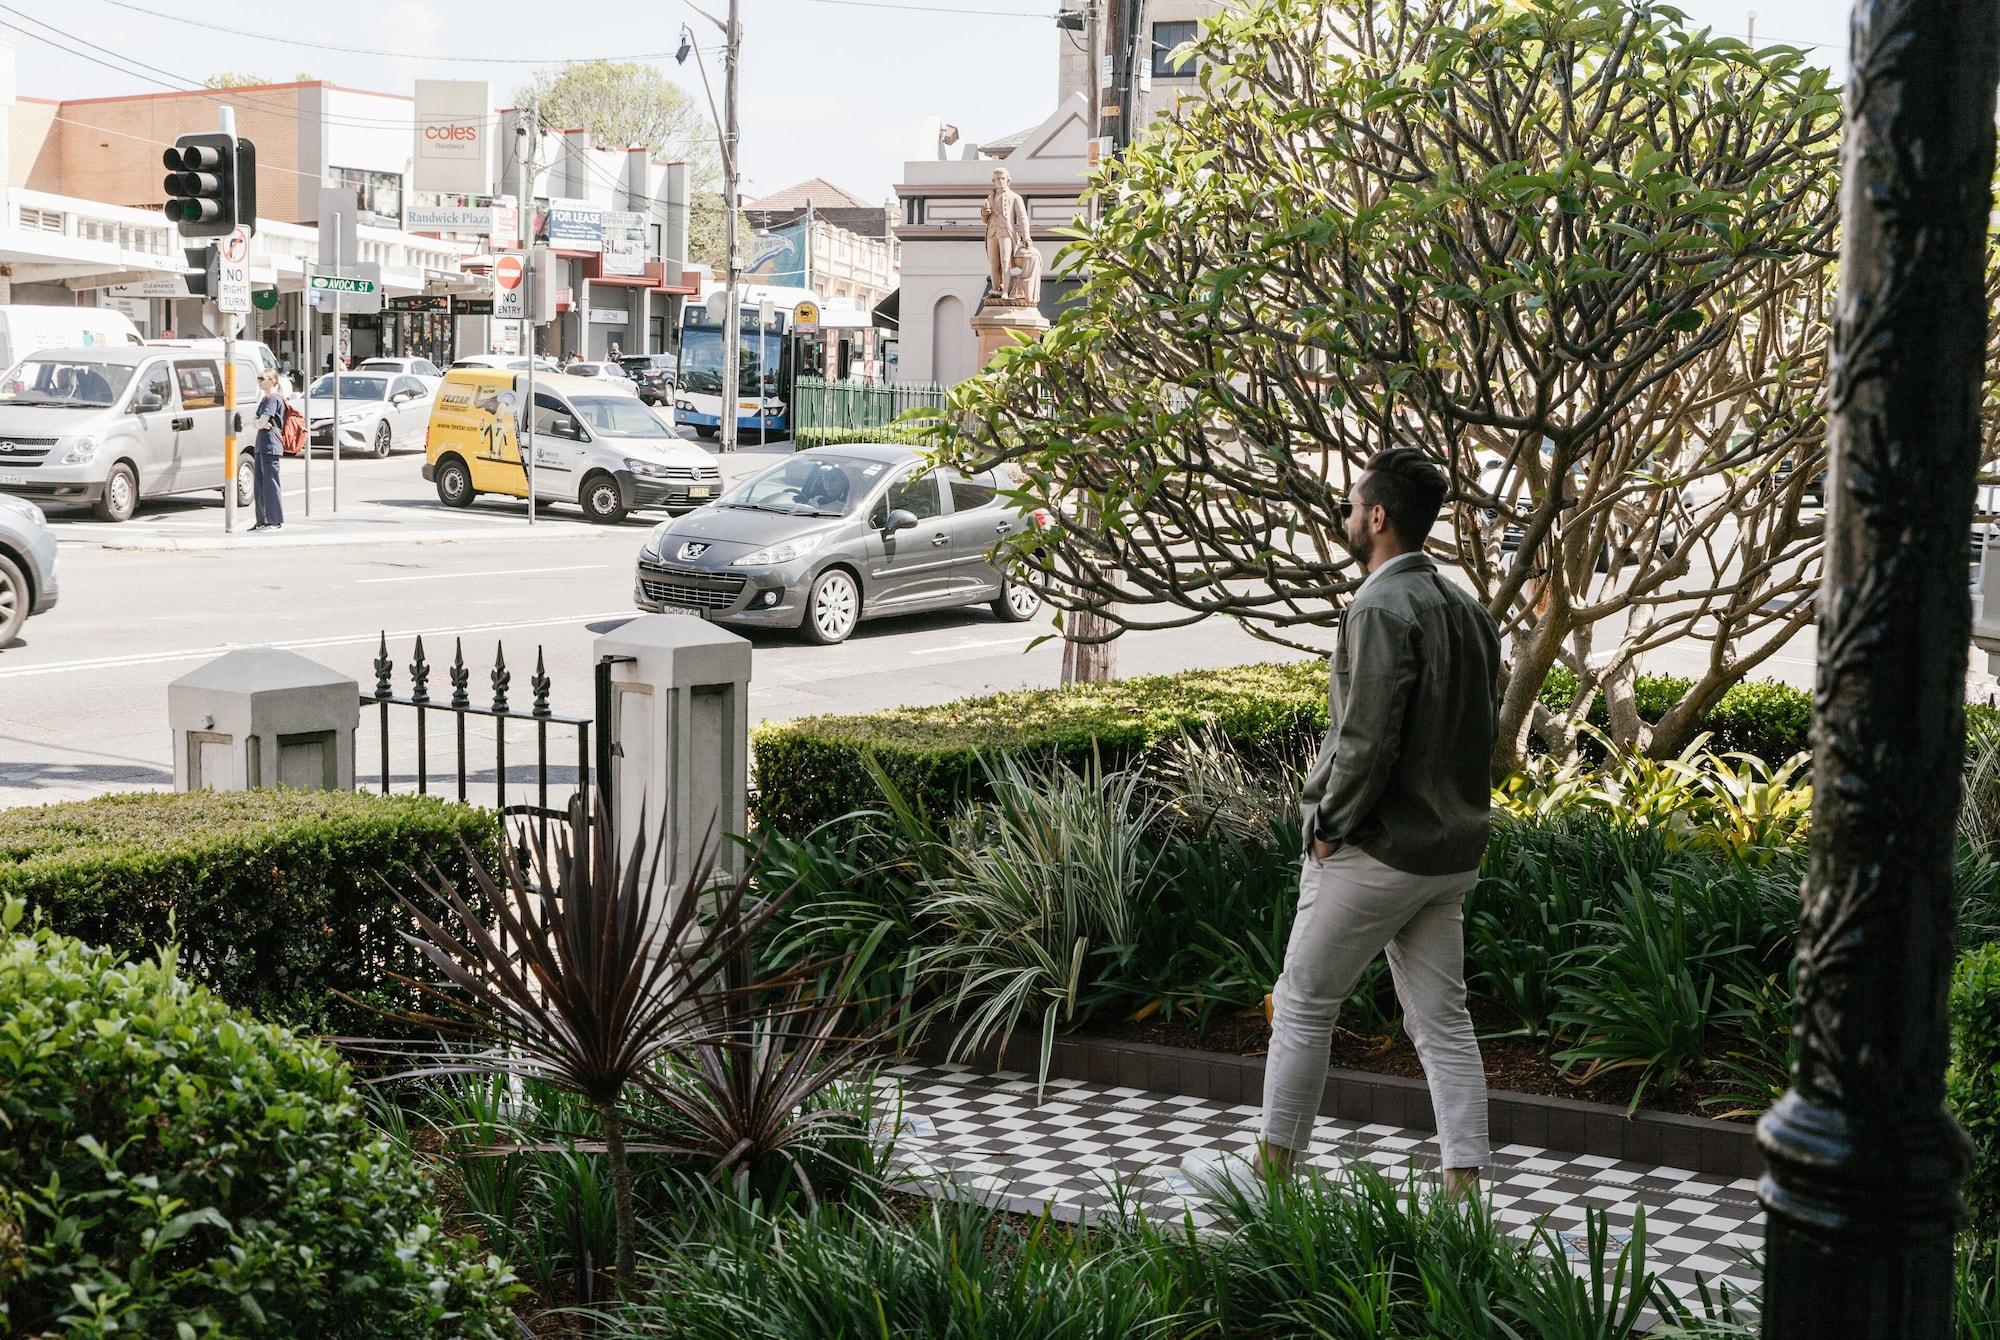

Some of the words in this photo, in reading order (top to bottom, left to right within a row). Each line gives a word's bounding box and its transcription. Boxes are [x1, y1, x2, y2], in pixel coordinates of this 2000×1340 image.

[426, 124, 476, 141] coles
[408, 211, 458, 223] Randwick
[462, 212, 490, 224] Plaza
[552, 211, 572, 222] FOR
[573, 212, 600, 224] LEASE
[227, 269, 243, 282] NO
[224, 285, 247, 294] RIGHT
[328, 279, 355, 291] AVOCA
[358, 281, 369, 292] ST
[224, 297, 246, 306] TURN
[503, 293, 516, 303] NO
[498, 306, 521, 314] ENTRY
[442, 394, 470, 405] TEXTAR
[437, 423, 478, 432] www.textar.com
